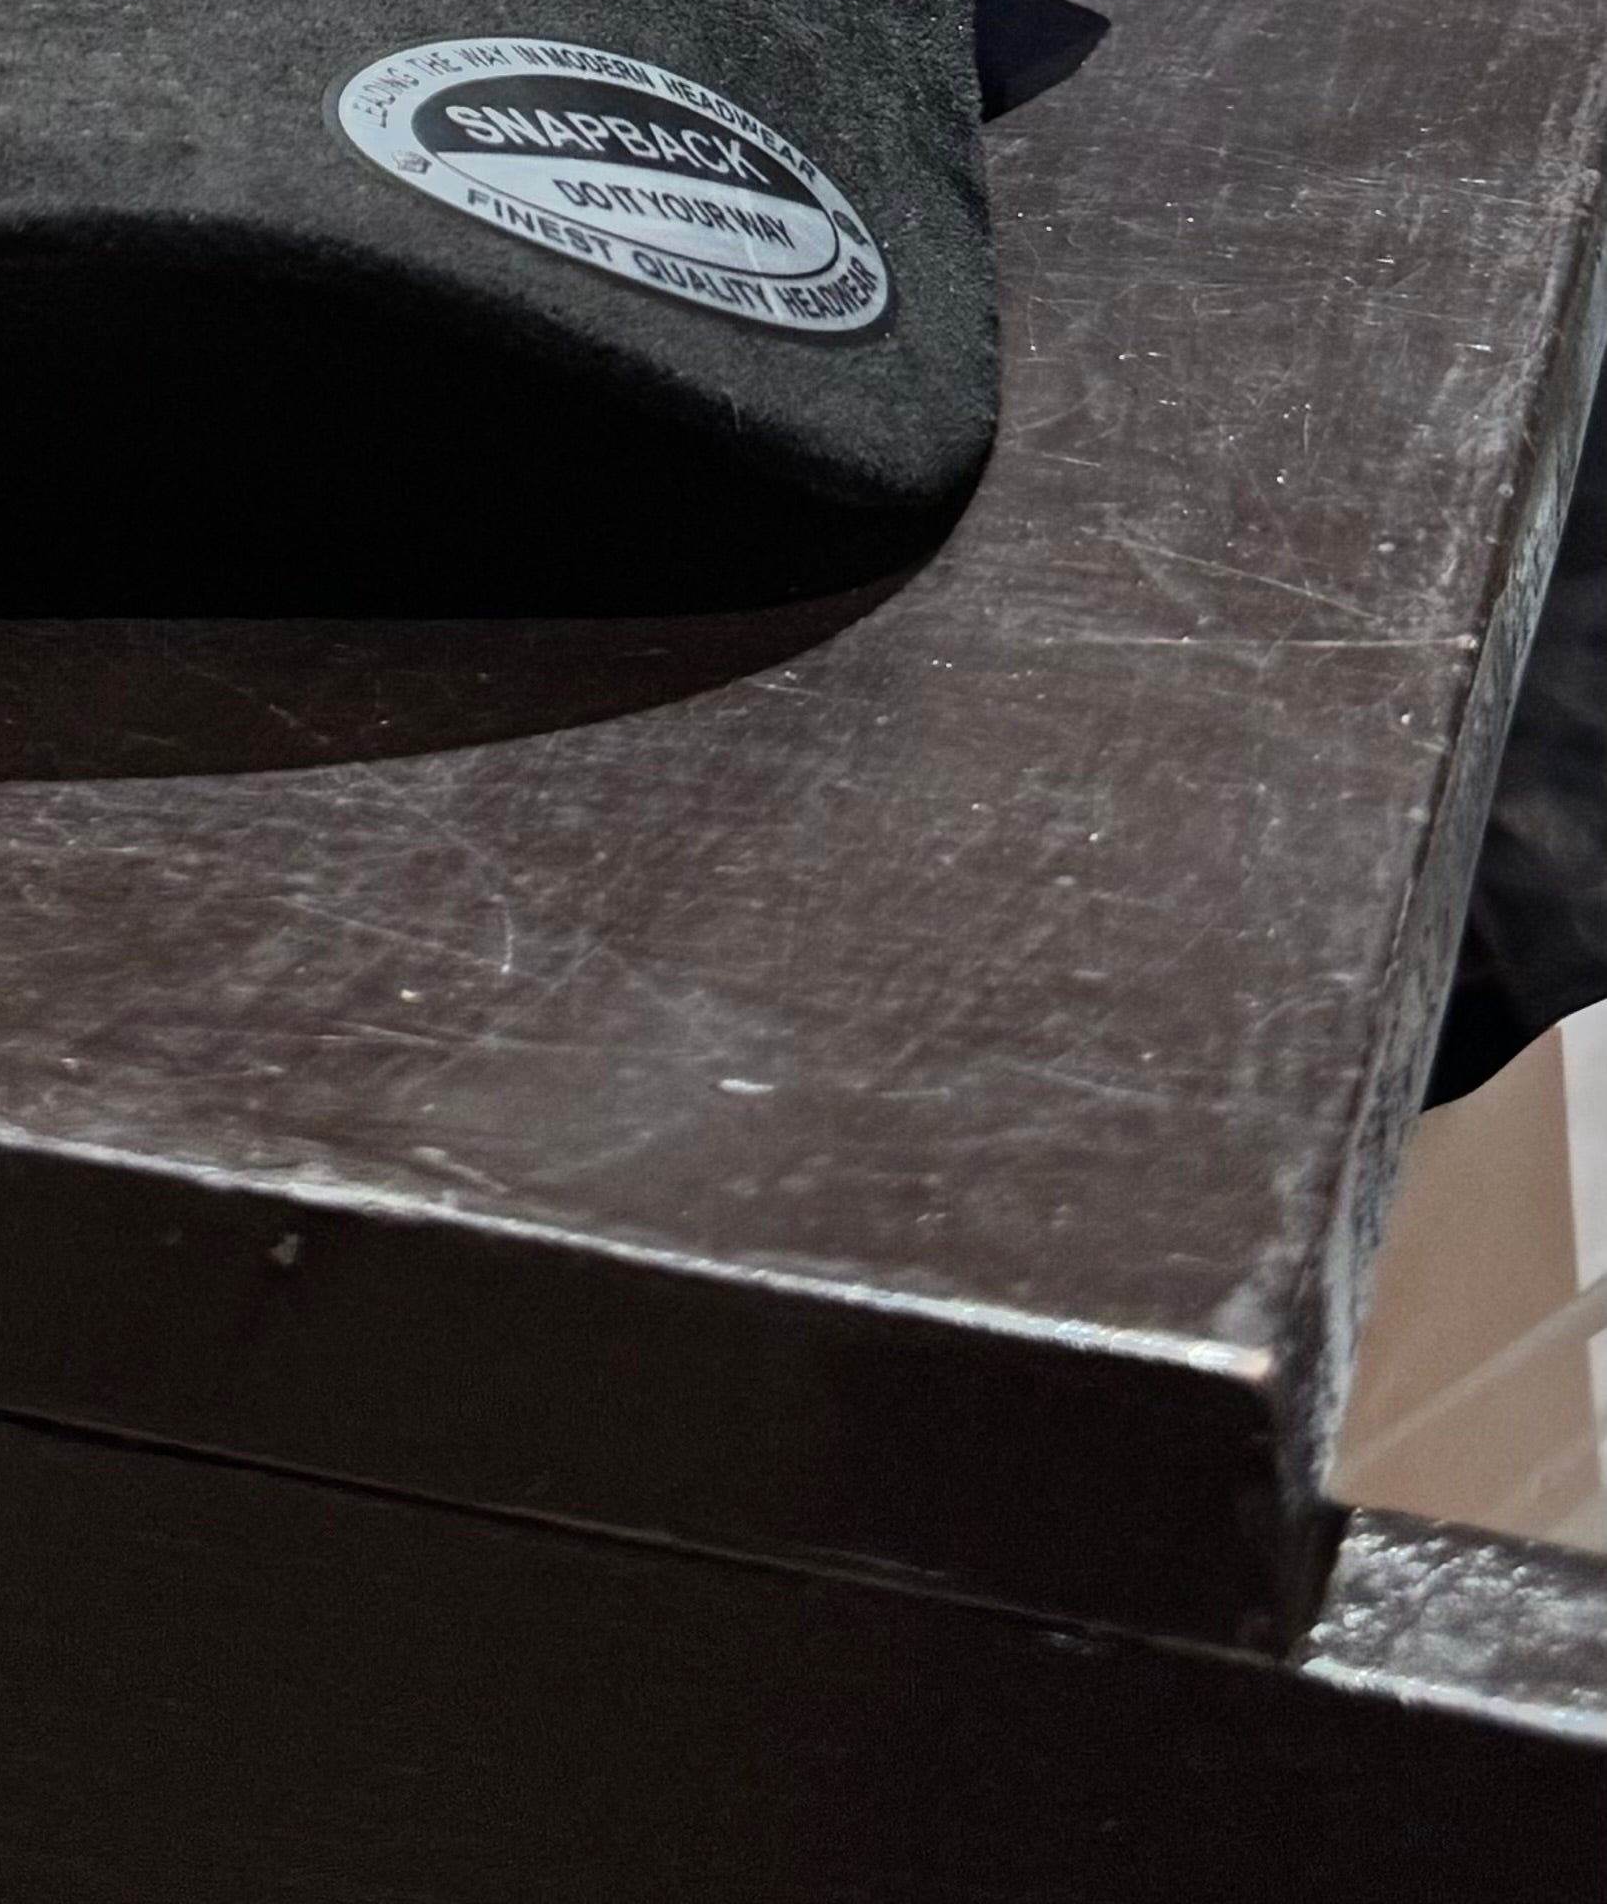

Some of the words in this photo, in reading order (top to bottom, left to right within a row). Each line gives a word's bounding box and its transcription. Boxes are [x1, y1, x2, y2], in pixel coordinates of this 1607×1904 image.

[405, 51, 463, 77] THE
[452, 44, 512, 69] WAY
[510, 43, 543, 68] IN
[544, 45, 656, 89] MODERN
[659, 74, 817, 183] HEADWEAR
[445, 104, 770, 185] SNAPBACK
[466, 188, 613, 262] FINEST
[631, 249, 774, 315] QUALITY
[774, 254, 879, 320] HEADWEAR
